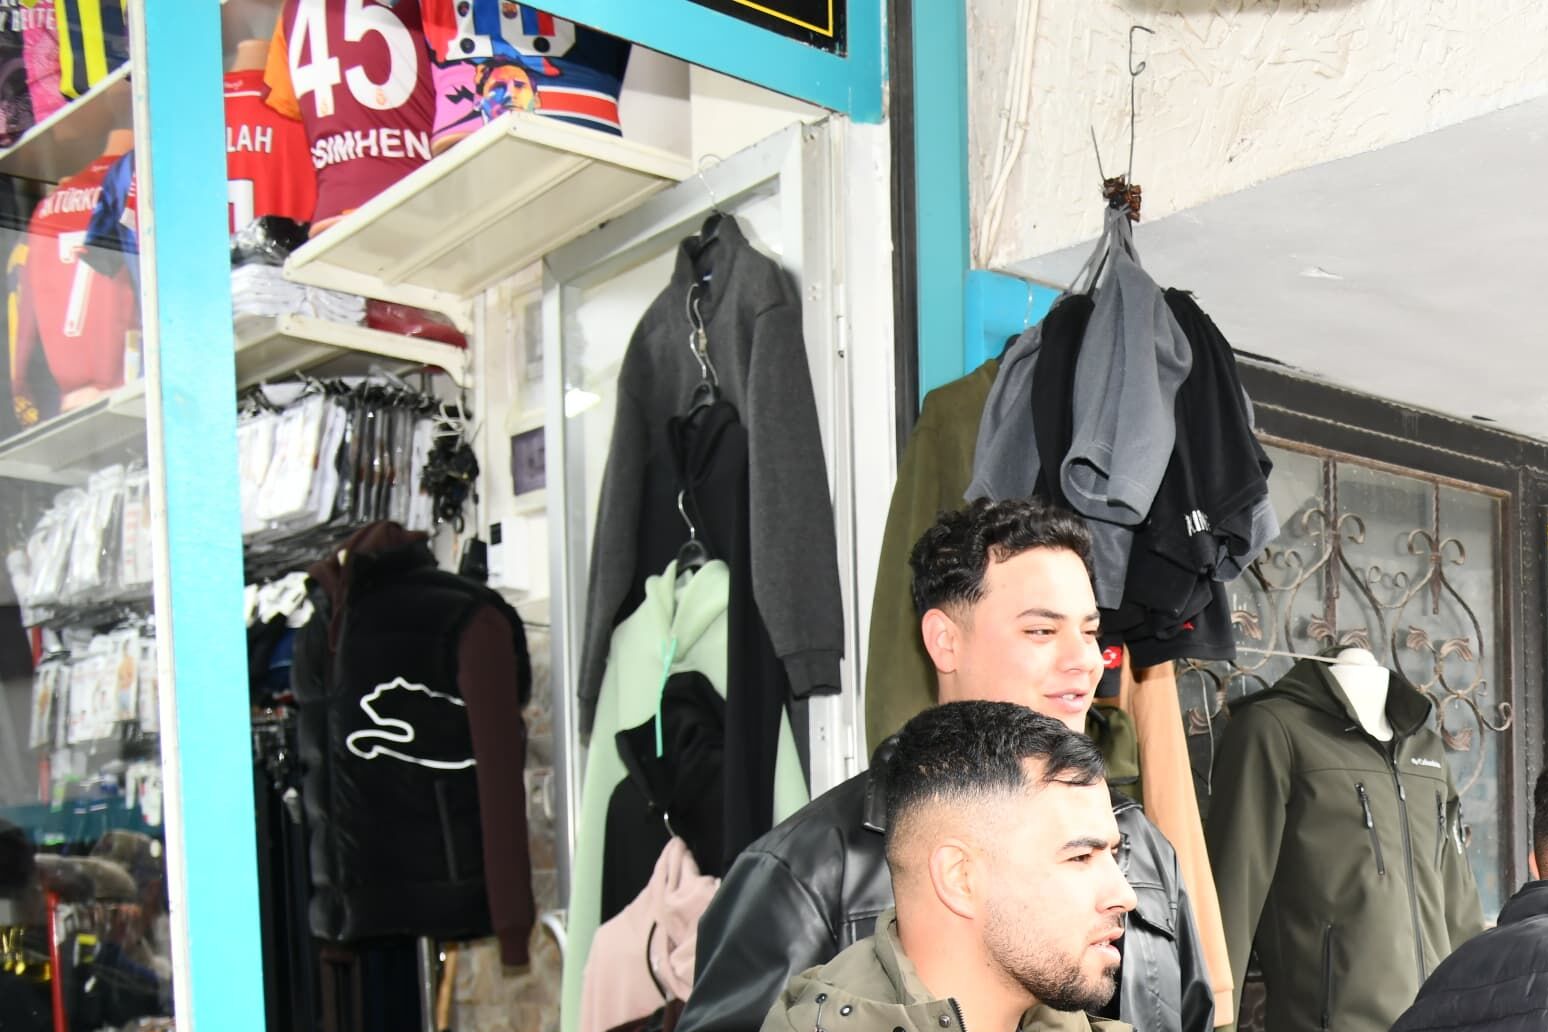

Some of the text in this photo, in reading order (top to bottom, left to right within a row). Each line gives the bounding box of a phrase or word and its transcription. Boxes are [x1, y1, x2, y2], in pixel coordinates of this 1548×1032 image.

[12, 8, 58, 32] BETTE
[289, 0, 418, 118] 45
[227, 124, 273, 154] LAH
[310, 128, 433, 169] SIMHEN
